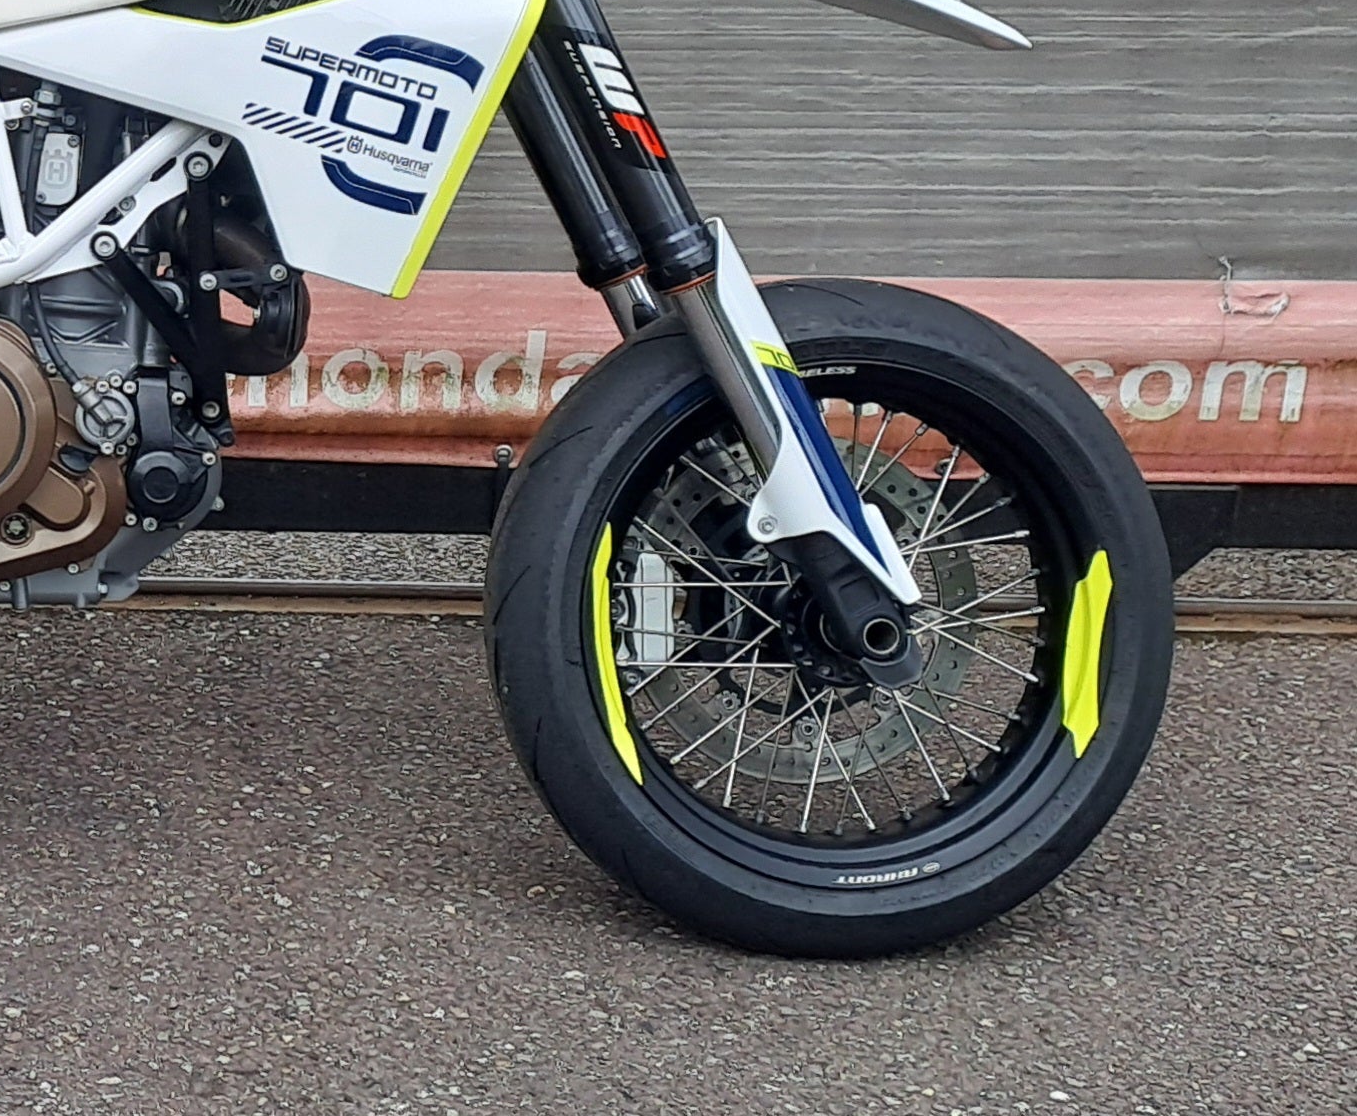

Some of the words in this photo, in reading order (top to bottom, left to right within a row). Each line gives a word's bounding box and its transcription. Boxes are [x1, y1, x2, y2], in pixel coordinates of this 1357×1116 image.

[264, 36, 438, 101] SUPERMOTO
[260, 54, 450, 153] 701
[362, 143, 430, 172] Husqvarna
